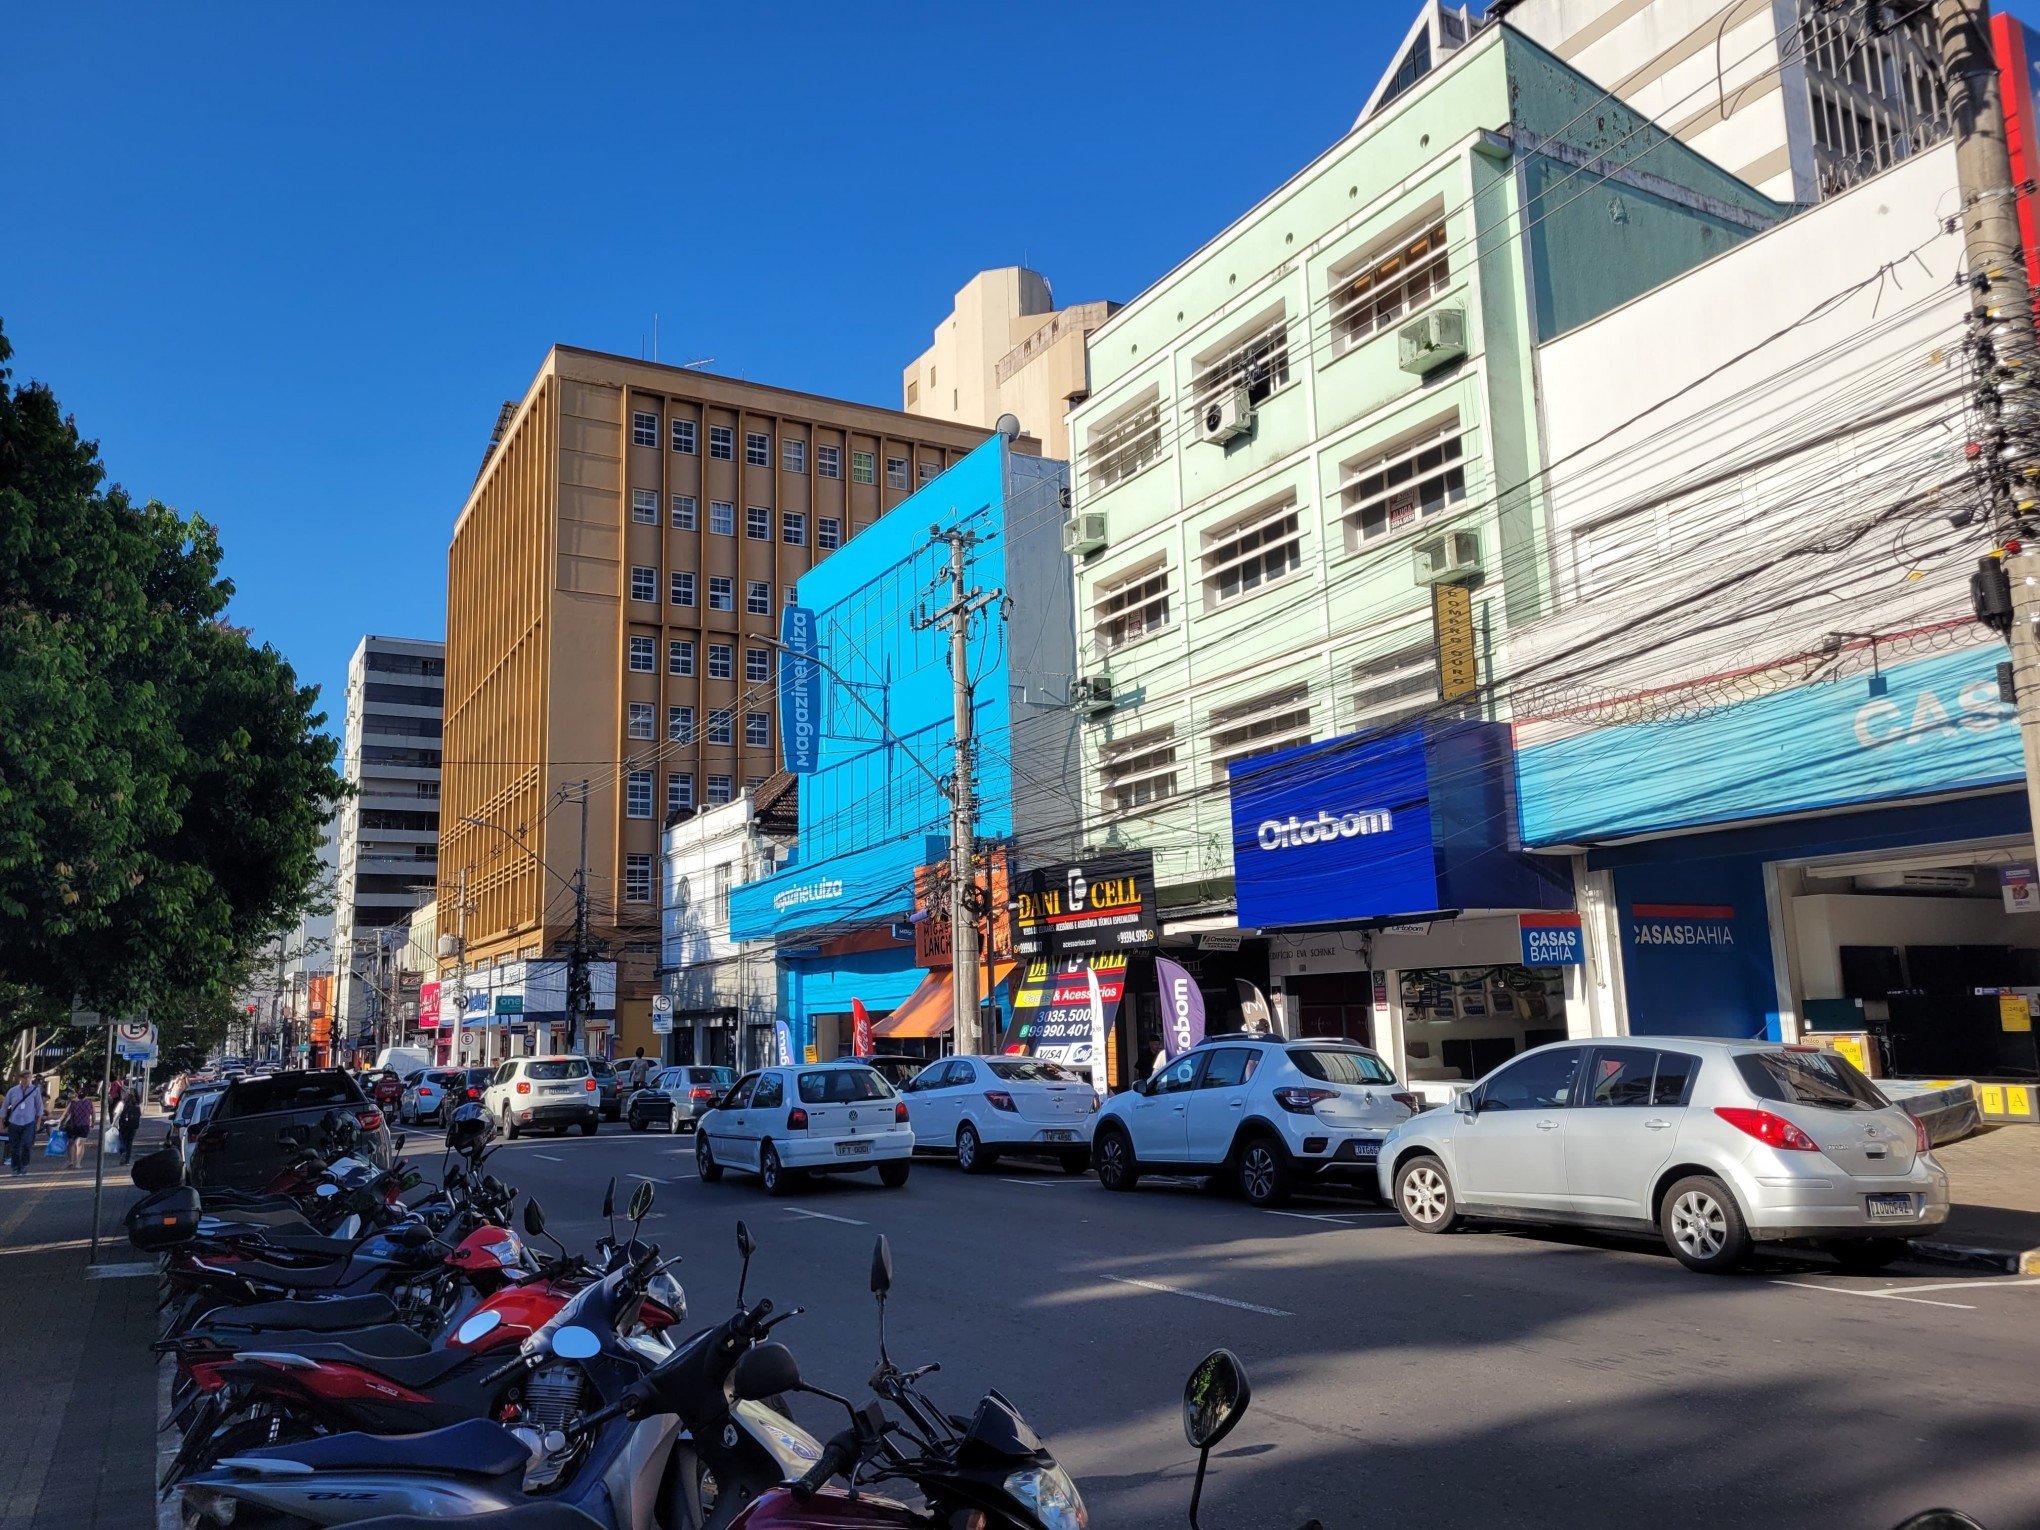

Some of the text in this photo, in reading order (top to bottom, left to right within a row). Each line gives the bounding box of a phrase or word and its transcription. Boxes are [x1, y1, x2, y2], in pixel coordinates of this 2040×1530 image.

[1854, 679, 2022, 748] CAS
[1257, 807, 1393, 851] Ortobom
[1018, 877, 1141, 920] DANI CELL
[924, 934, 953, 957] LANCH
[1529, 930, 1576, 947] CASAS
[1530, 945, 1573, 962] BAHIA
[1053, 992, 1060, 1002] &
[1062, 986, 1117, 1001] Acessrios
[1037, 1008, 1093, 1023] 3035.500
[1039, 1048, 1063, 1059] VISA
[1986, 1091, 2025, 1107] T A
